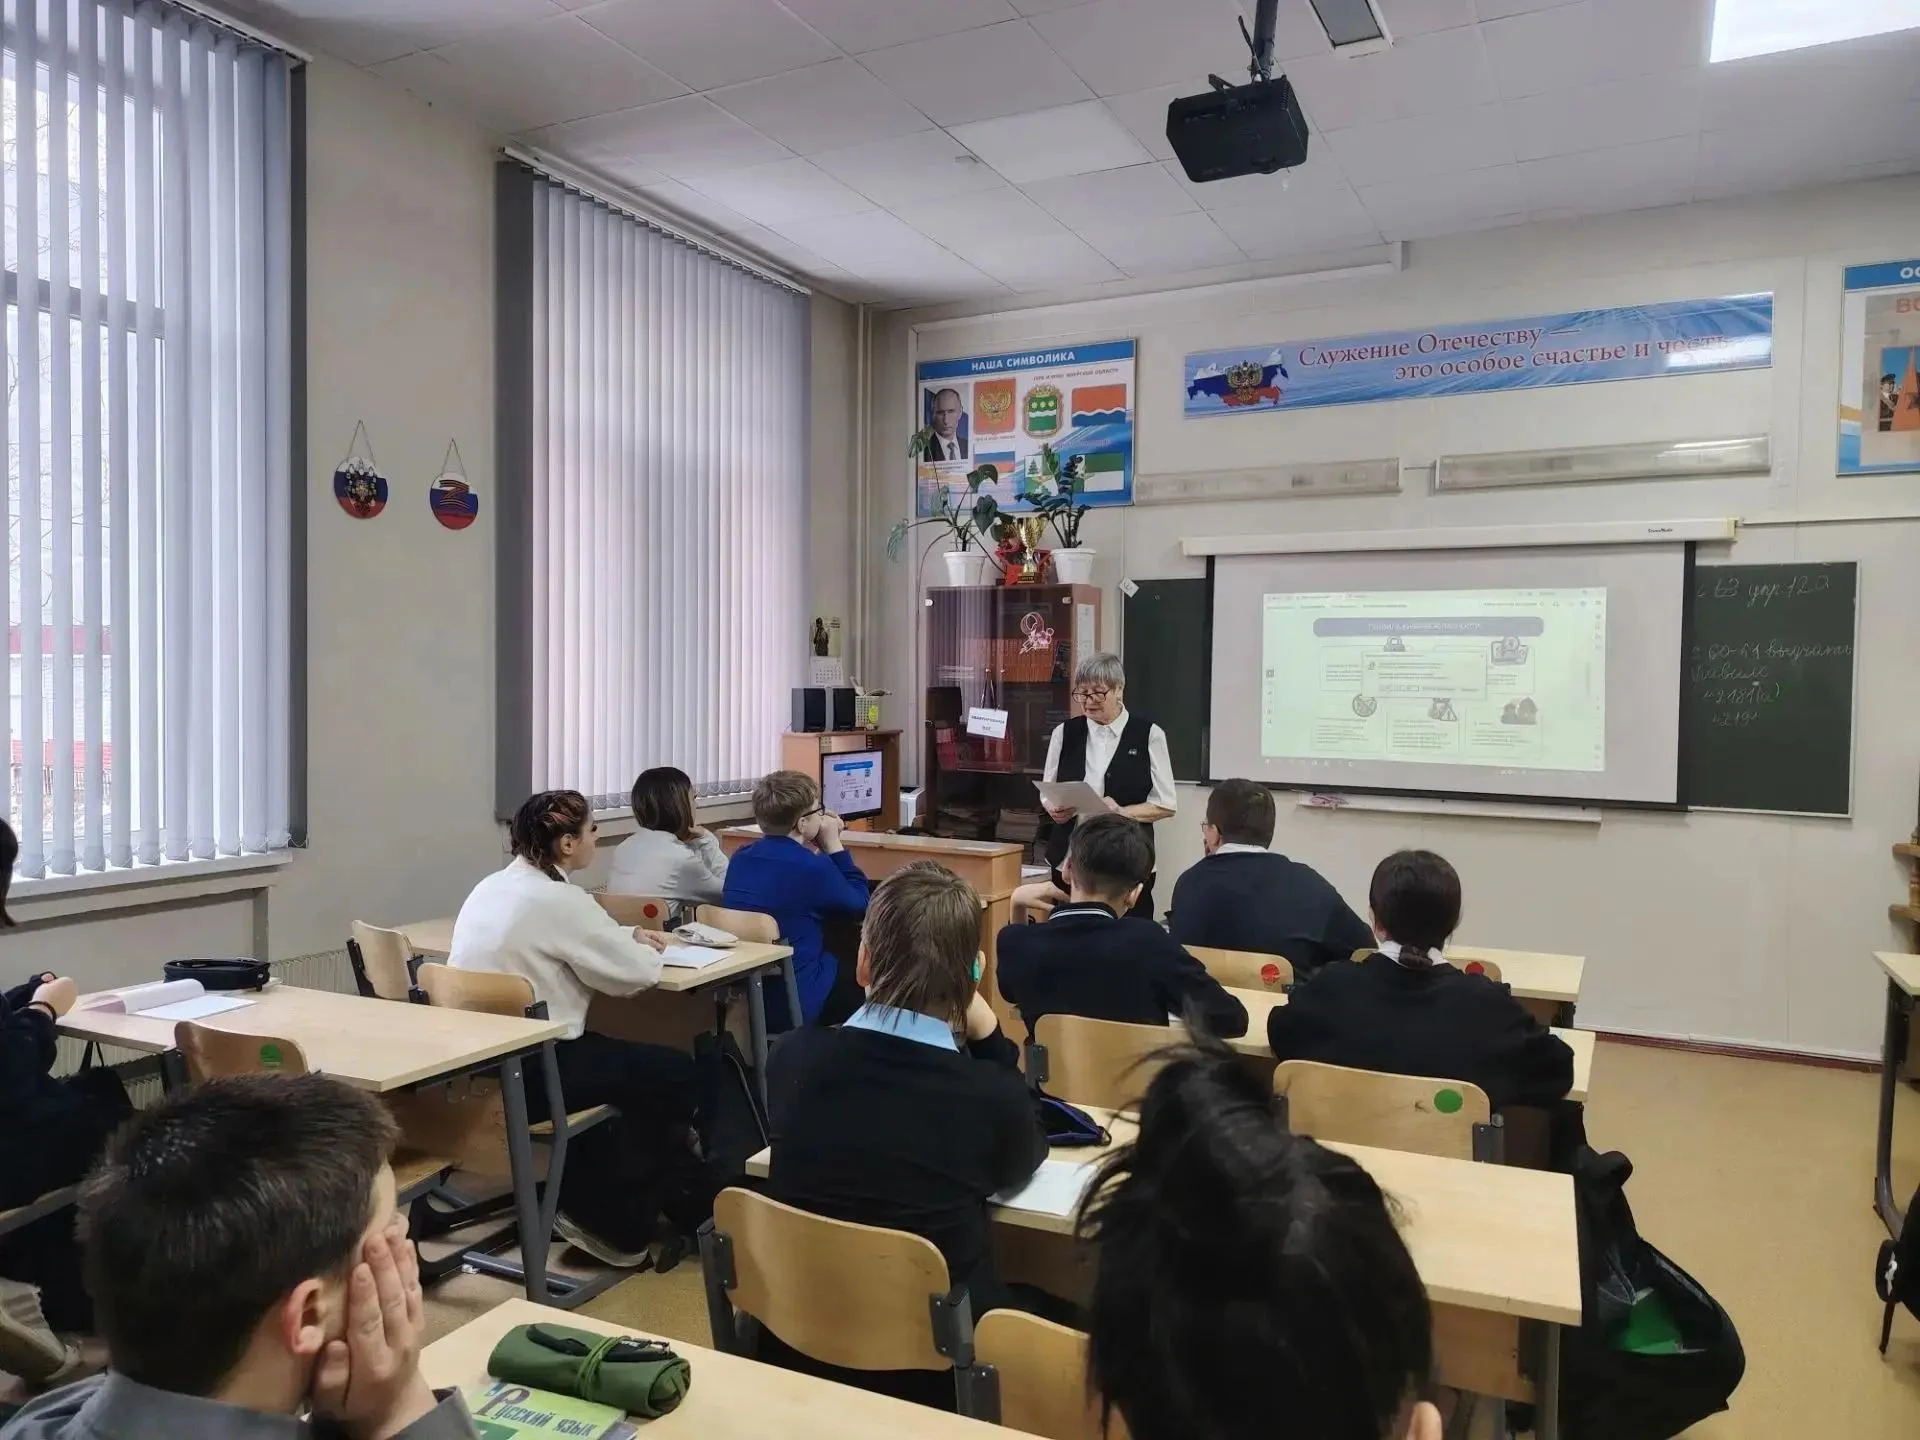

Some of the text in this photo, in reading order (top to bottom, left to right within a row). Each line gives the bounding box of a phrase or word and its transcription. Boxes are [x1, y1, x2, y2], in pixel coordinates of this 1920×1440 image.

[971, 351, 1075, 371] НАША СИМВОЛИКА
[1299, 341, 1410, 369] Служение
[1417, 327, 1543, 354] Отечеству
[1395, 363, 1433, 379] это
[1440, 351, 1525, 376] особое
[1532, 345, 1626, 367] счастье
[1634, 343, 1649, 358] и
[472, 1387, 598, 1437] Русский язык
